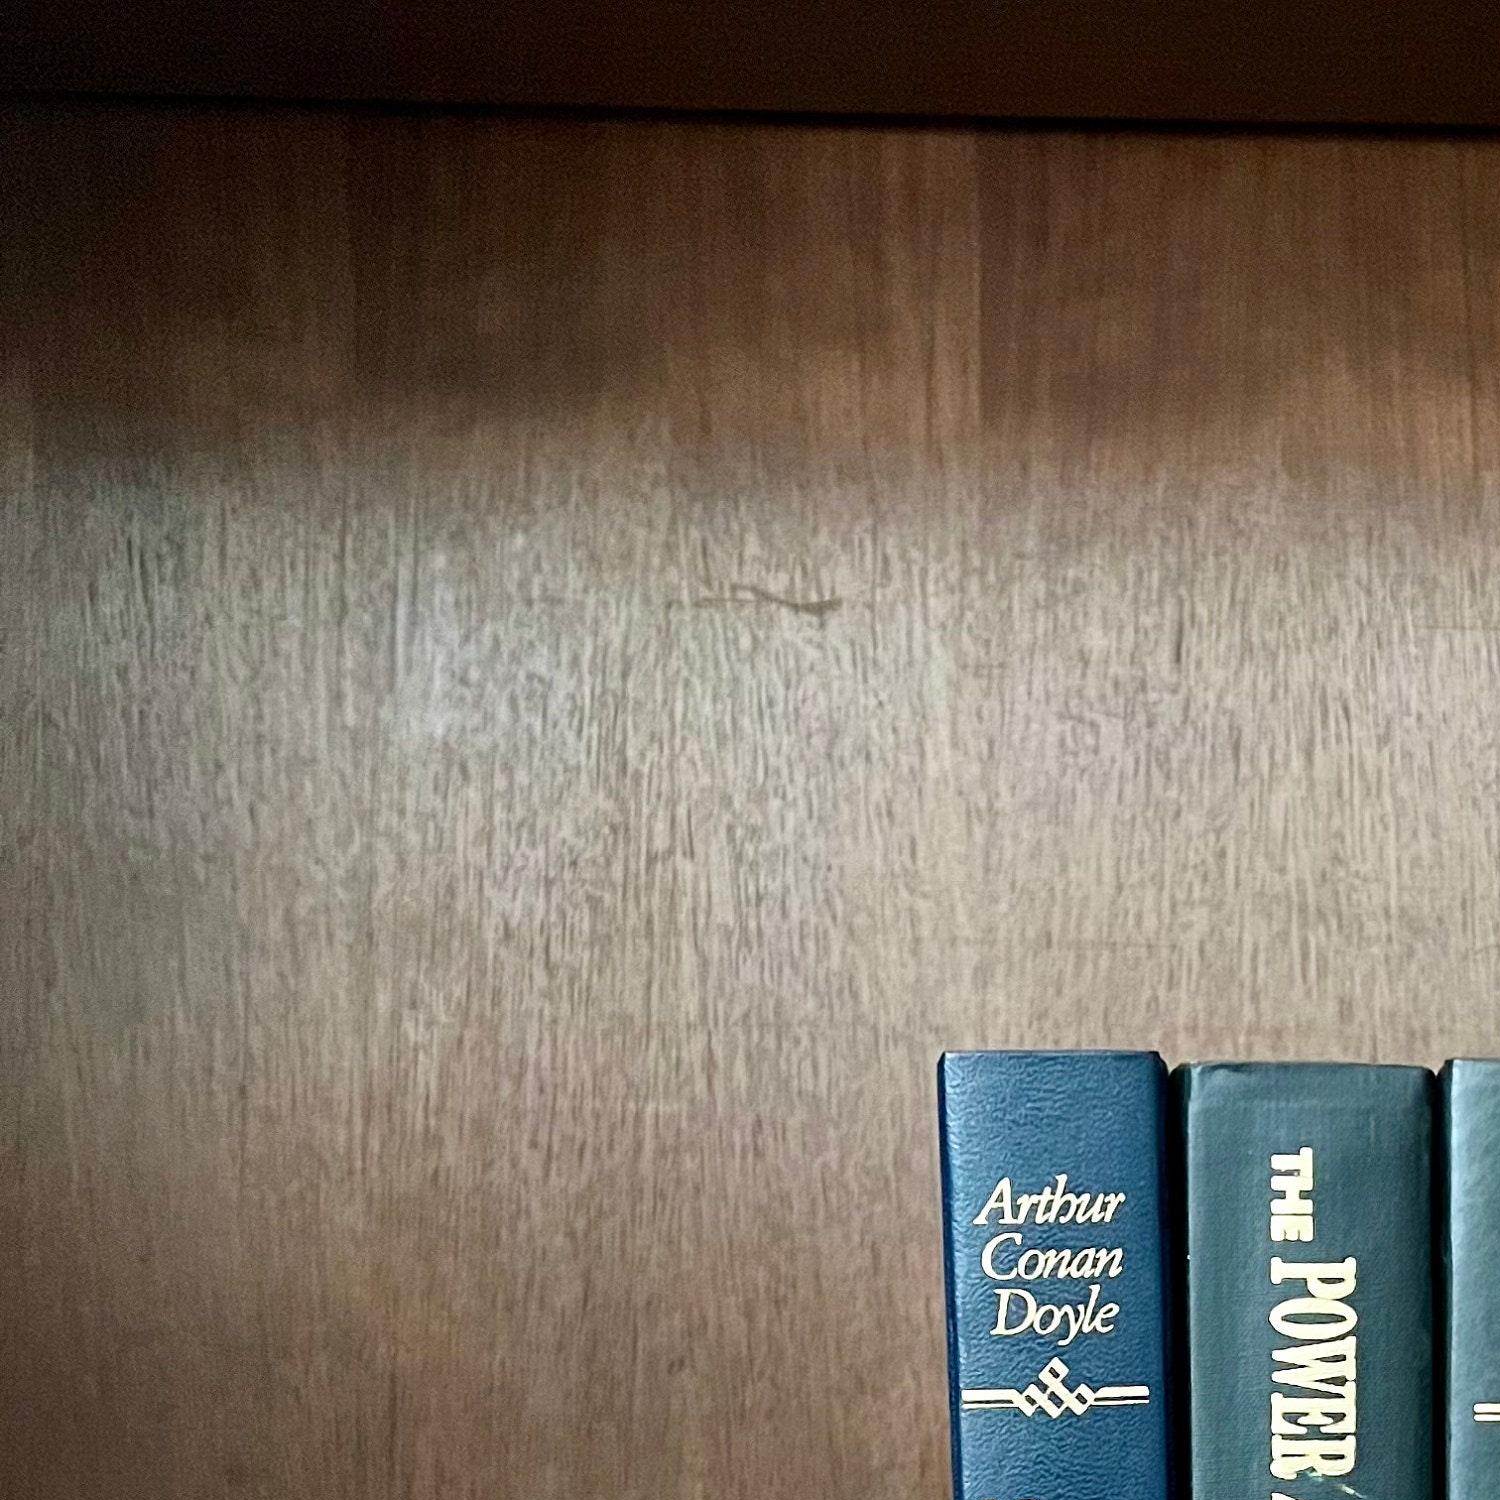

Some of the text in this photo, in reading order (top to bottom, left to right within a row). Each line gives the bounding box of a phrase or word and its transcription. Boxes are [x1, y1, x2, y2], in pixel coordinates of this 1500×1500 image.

[972, 1173, 1126, 1225] Arthur
[1269, 1146, 1314, 1242] THE
[981, 1232, 1123, 1281] Conan
[989, 1285, 1120, 1346] Doyle
[1268, 1256, 1358, 1480] POWER
